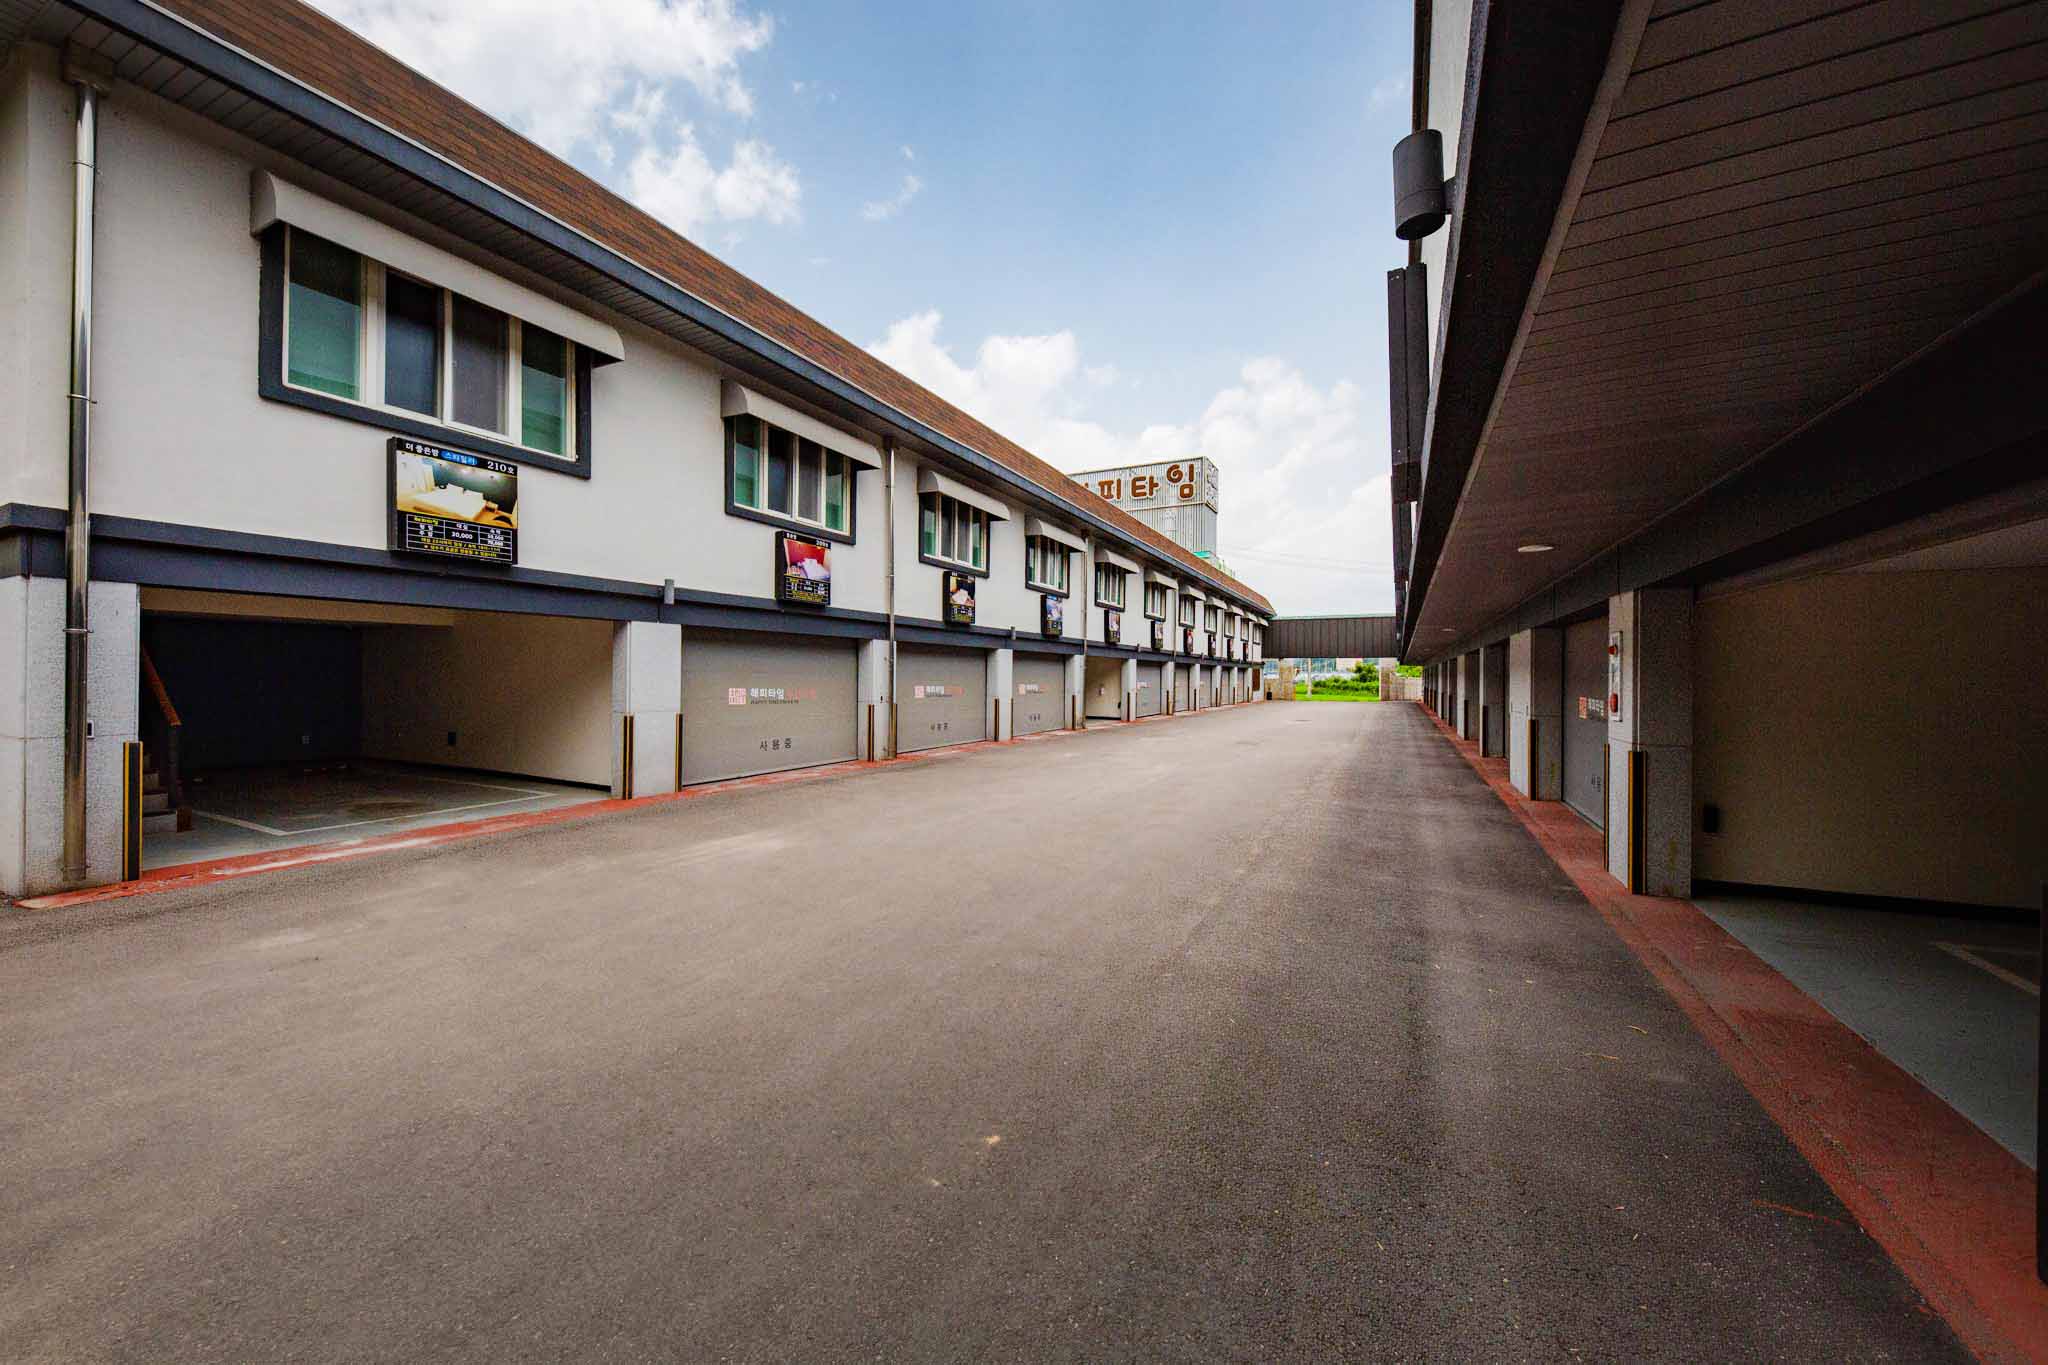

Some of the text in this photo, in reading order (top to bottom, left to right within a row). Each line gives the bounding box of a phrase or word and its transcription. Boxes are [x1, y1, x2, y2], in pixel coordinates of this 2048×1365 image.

[487, 460, 515, 475] 210호
[1084, 463, 1195, 500] 피타임
[750, 688, 784, 700] 해피타임
